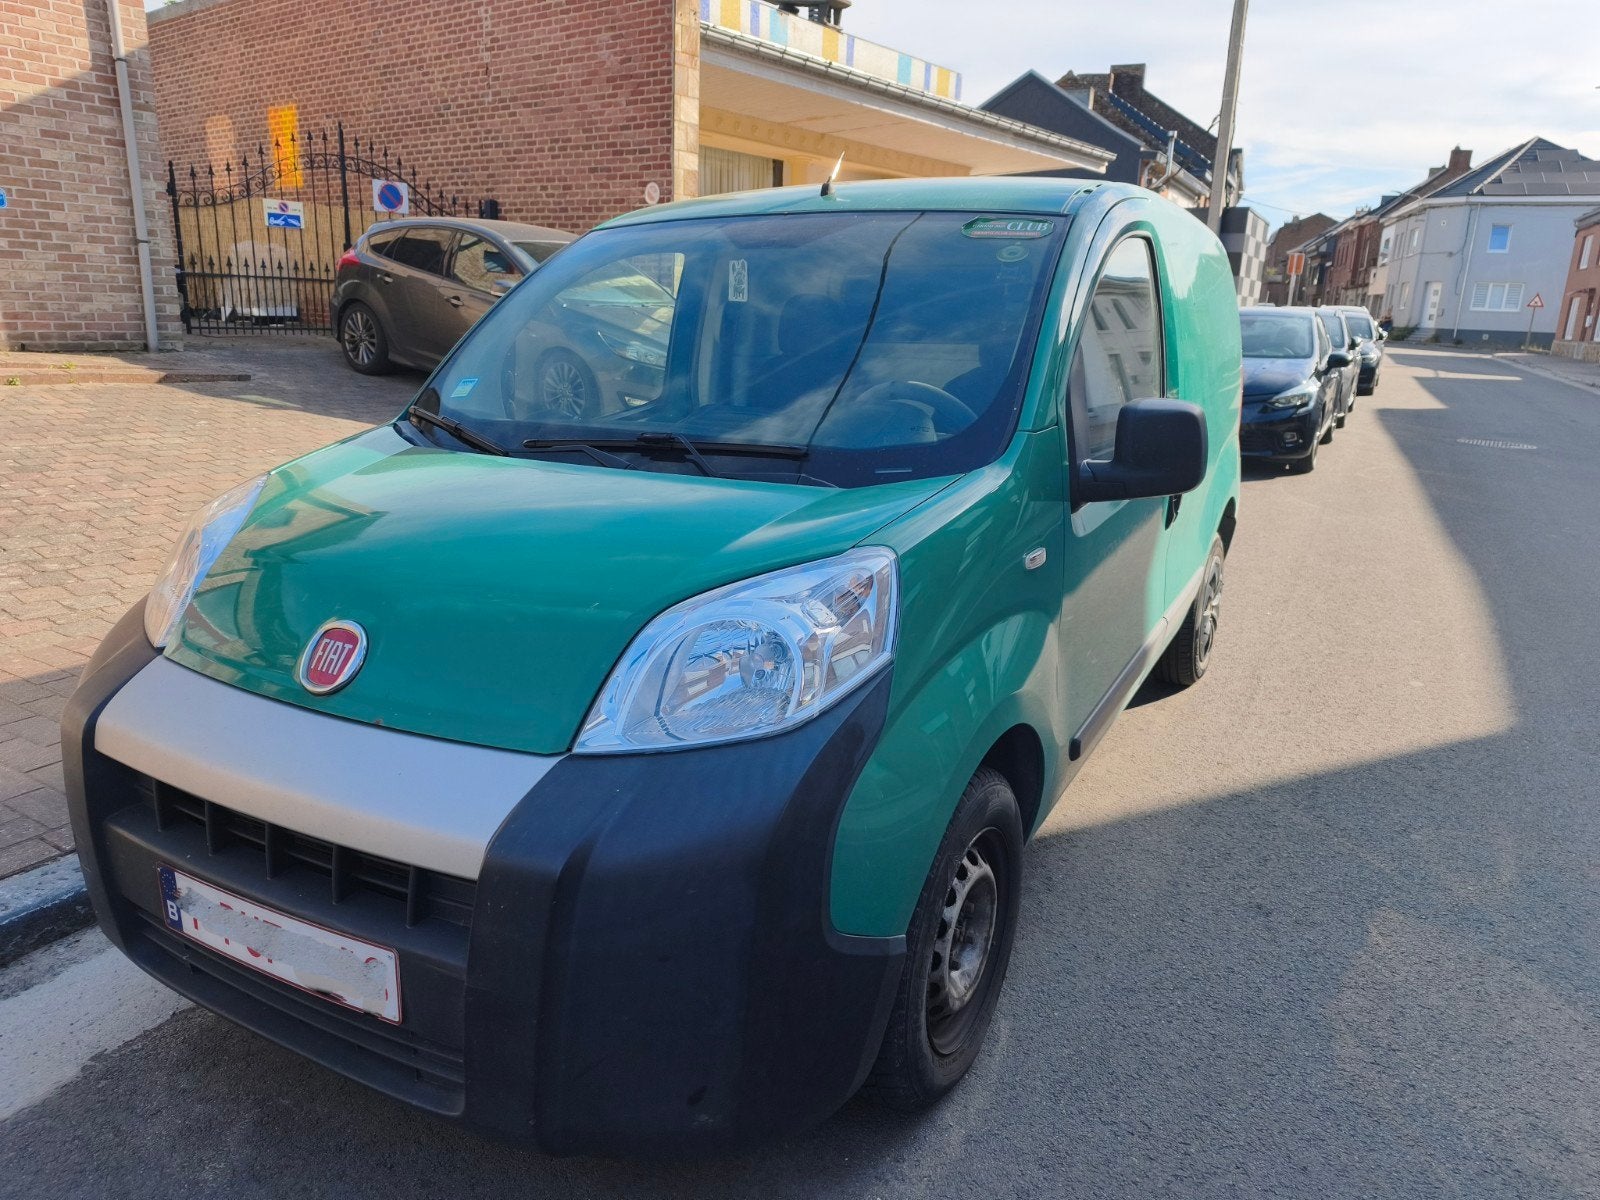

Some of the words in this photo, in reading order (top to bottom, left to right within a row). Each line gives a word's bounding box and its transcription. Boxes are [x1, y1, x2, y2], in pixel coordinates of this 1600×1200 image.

[1006, 221, 1048, 231] CLUB
[310, 638, 354, 676] FIAT
[167, 901, 179, 921] B
